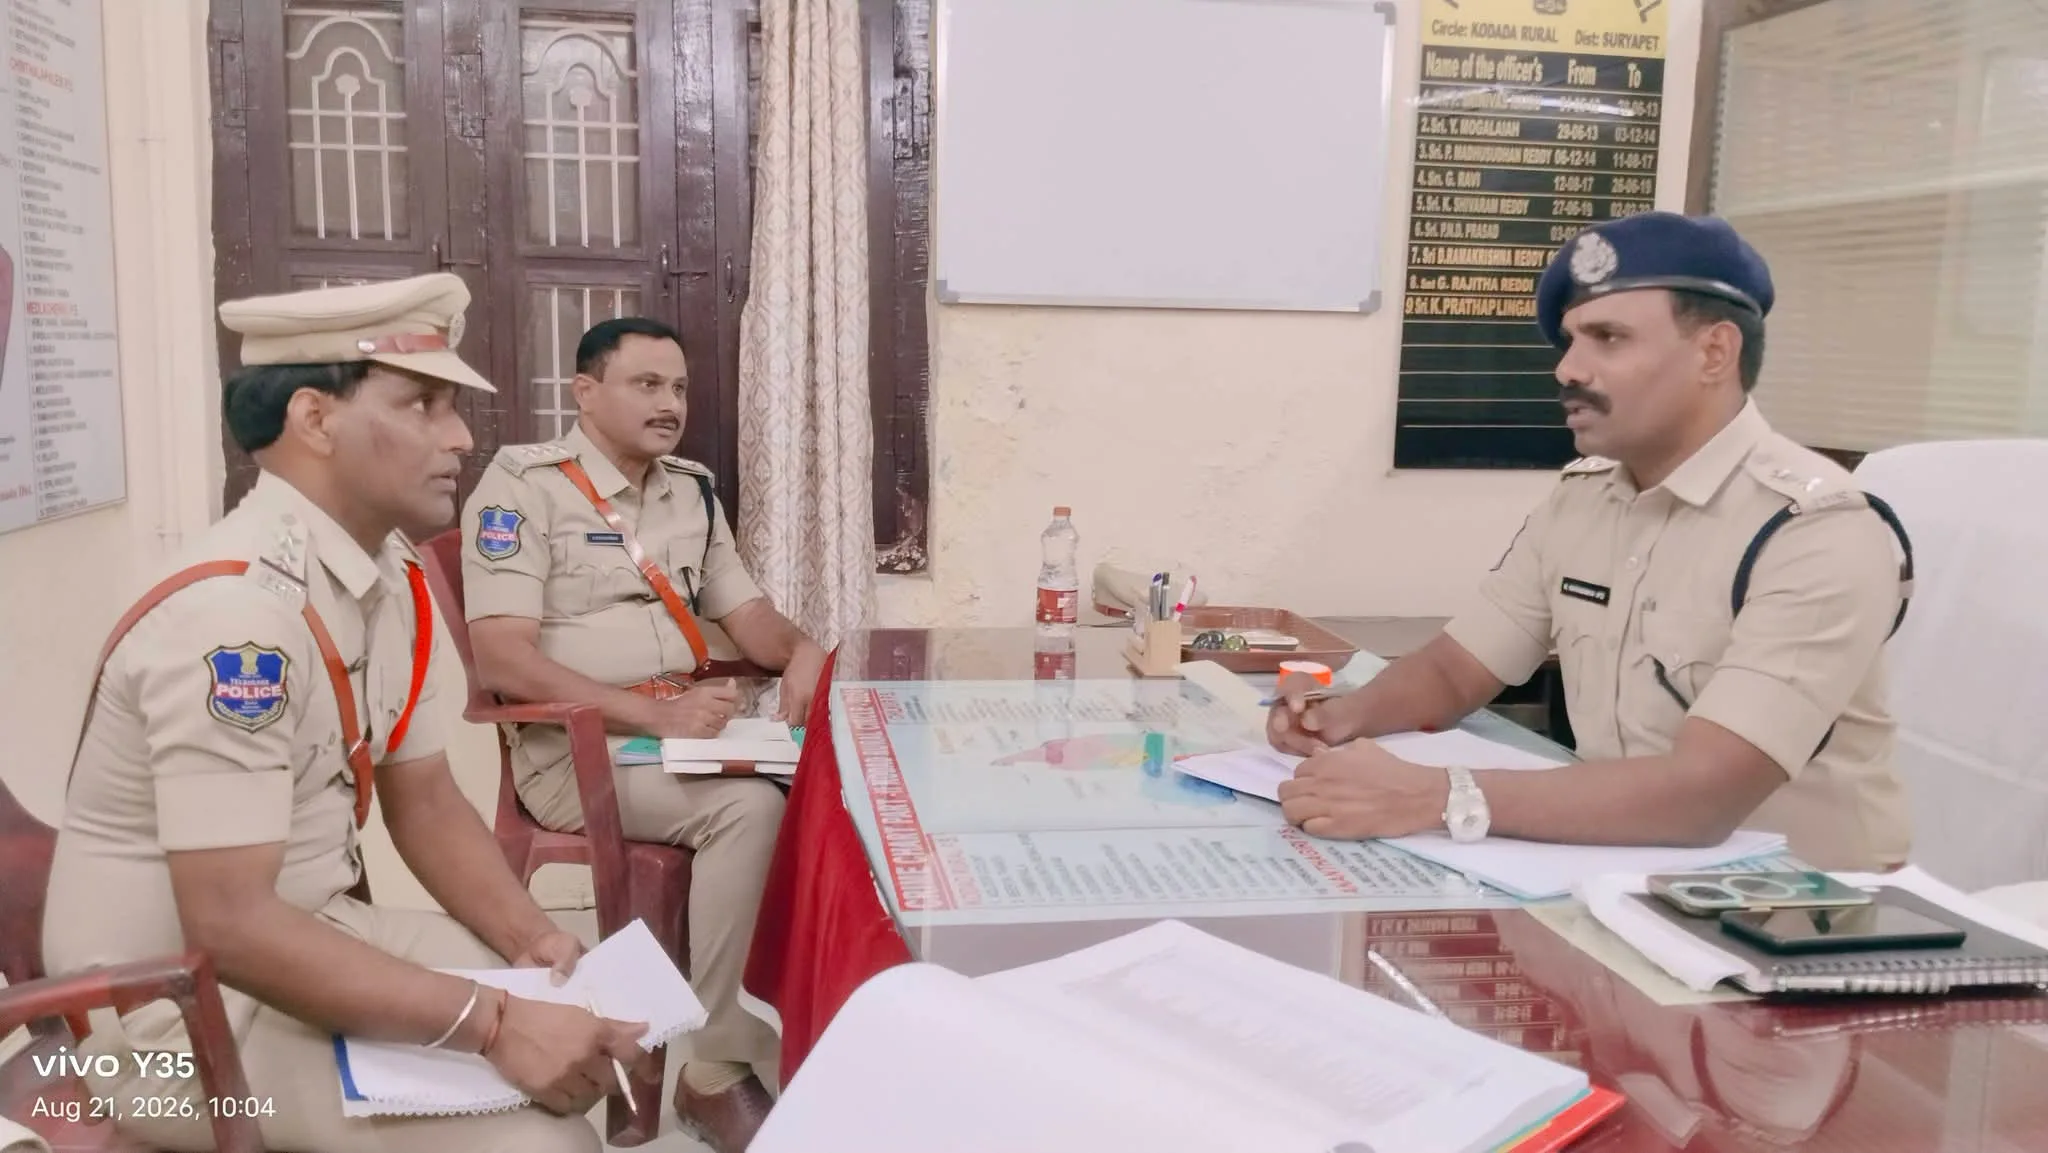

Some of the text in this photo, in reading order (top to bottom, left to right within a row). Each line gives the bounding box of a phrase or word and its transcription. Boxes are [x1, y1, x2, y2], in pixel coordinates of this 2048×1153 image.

[1431, 20, 1558, 43] Circle: KODADA RURAL
[1602, 32, 1660, 51] SURYAPET
[1426, 50, 1459, 79] Name
[1461, 52, 1474, 79] of
[1475, 53, 1495, 80] the
[1567, 58, 1597, 86] From
[1627, 62, 1642, 88] To
[1615, 127, 1657, 144] 03-12-14
[1451, 276, 1499, 292] RAJITHA
[480, 532, 518, 543] POLICE
[215, 683, 283, 700] POLICE
